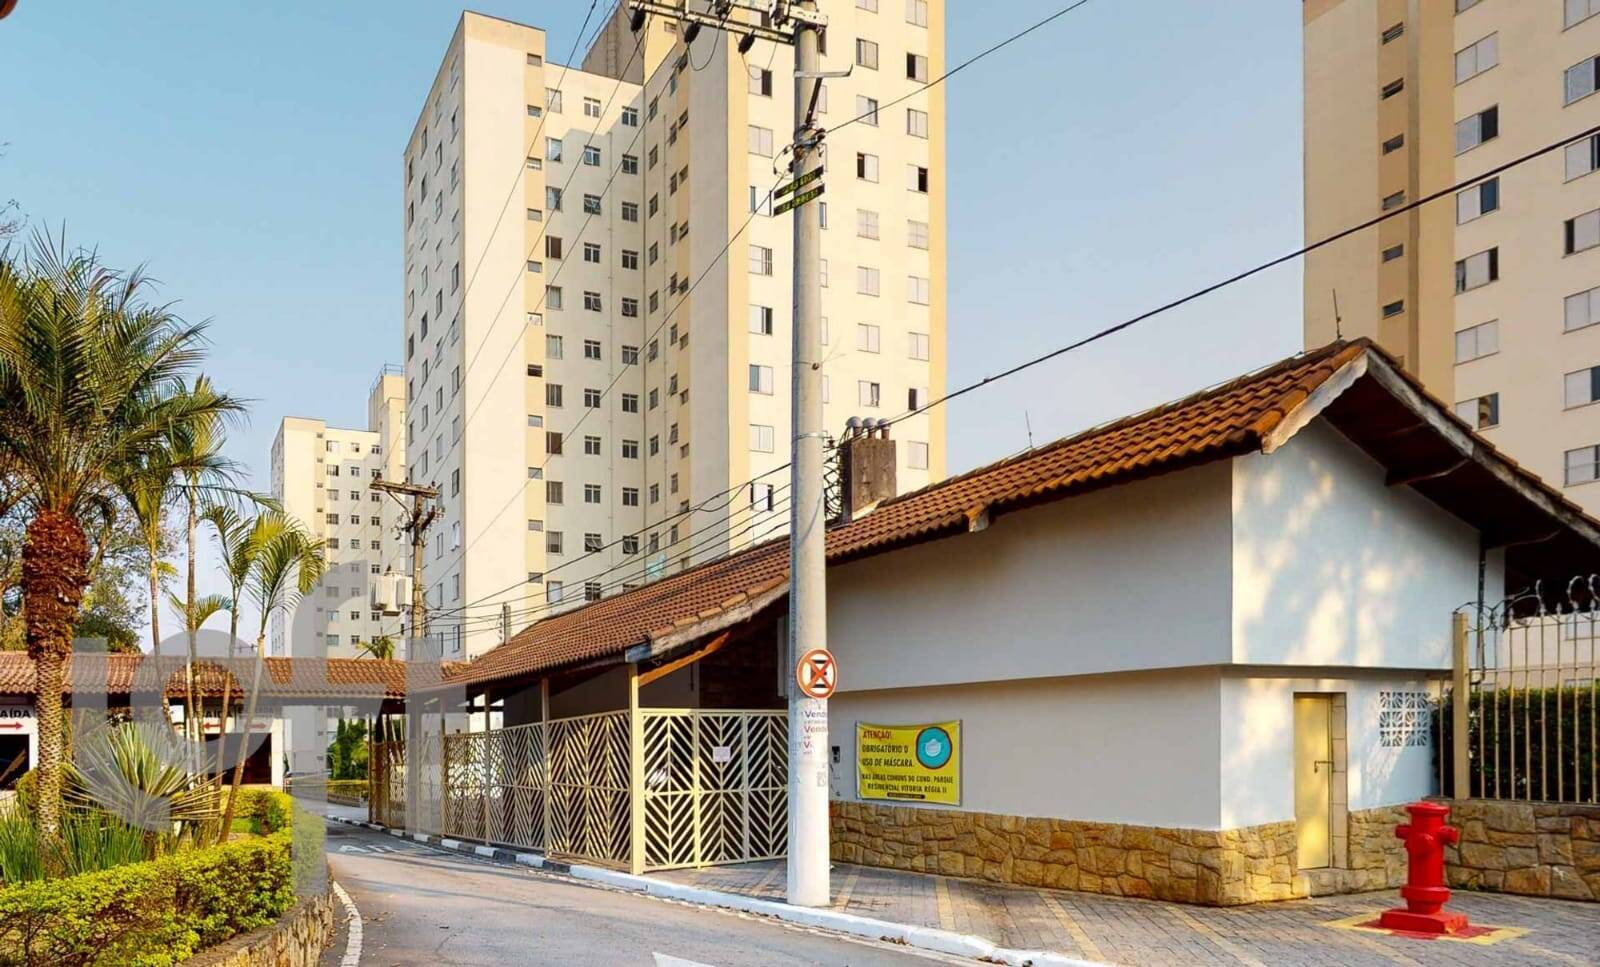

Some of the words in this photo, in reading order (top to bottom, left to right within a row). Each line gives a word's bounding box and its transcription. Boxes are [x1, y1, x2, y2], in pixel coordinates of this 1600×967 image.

[862, 729, 892, 741] ATENÇÃO!
[862, 742, 903, 753] OBRIGATÓRIO
[904, 744, 909, 754] O
[862, 757, 873, 766] USO
[874, 757, 882, 767] DE
[887, 774, 907, 782] COMUNS
[934, 776, 953, 784] PARQUE
[867, 783, 899, 791] RESIDENCIAL
